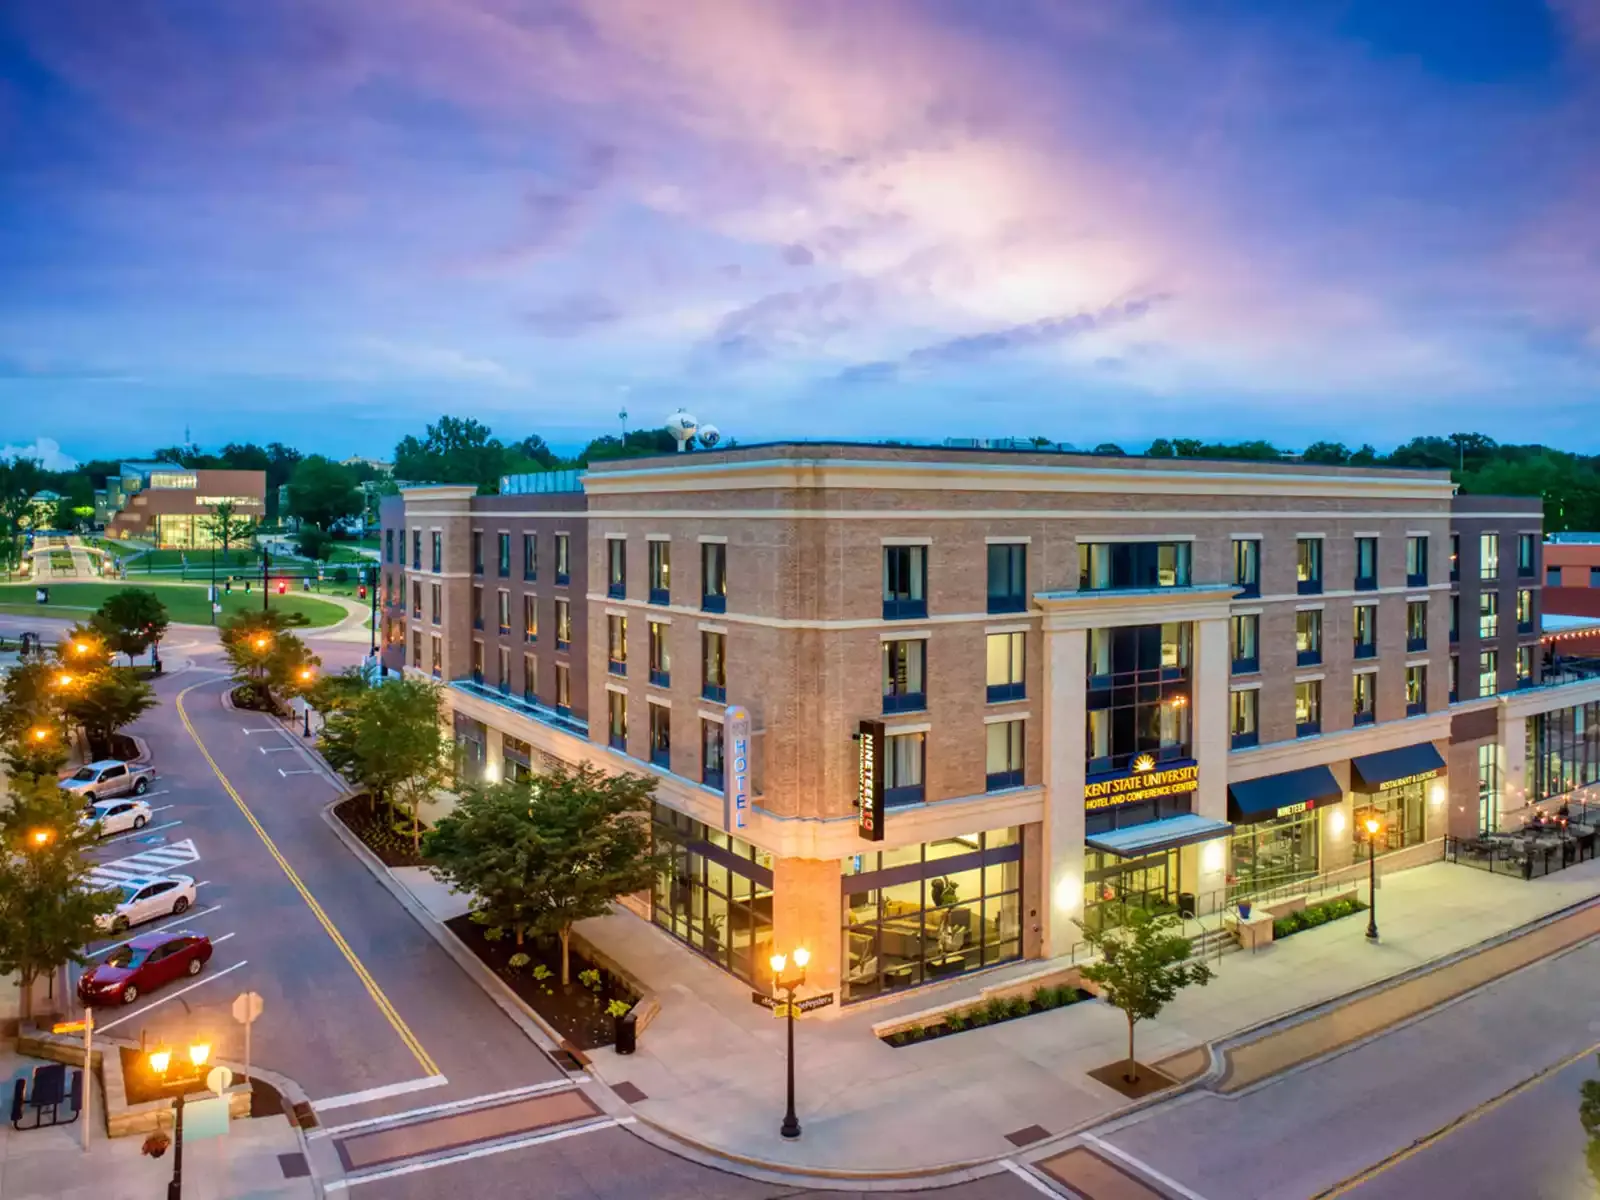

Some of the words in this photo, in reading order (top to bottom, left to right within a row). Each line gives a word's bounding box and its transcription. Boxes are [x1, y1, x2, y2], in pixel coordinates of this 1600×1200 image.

[735, 739, 747, 829] HOTEL
[1084, 781, 1111, 798] KENT
[1111, 776, 1141, 793] STATE
[1143, 766, 1199, 786] UNIVERSITY
[1085, 797, 1110, 809] HOTEL
[1109, 794, 1125, 806] AND
[1126, 785, 1170, 802] CONFERENCE
[1171, 781, 1198, 793] CENTER
